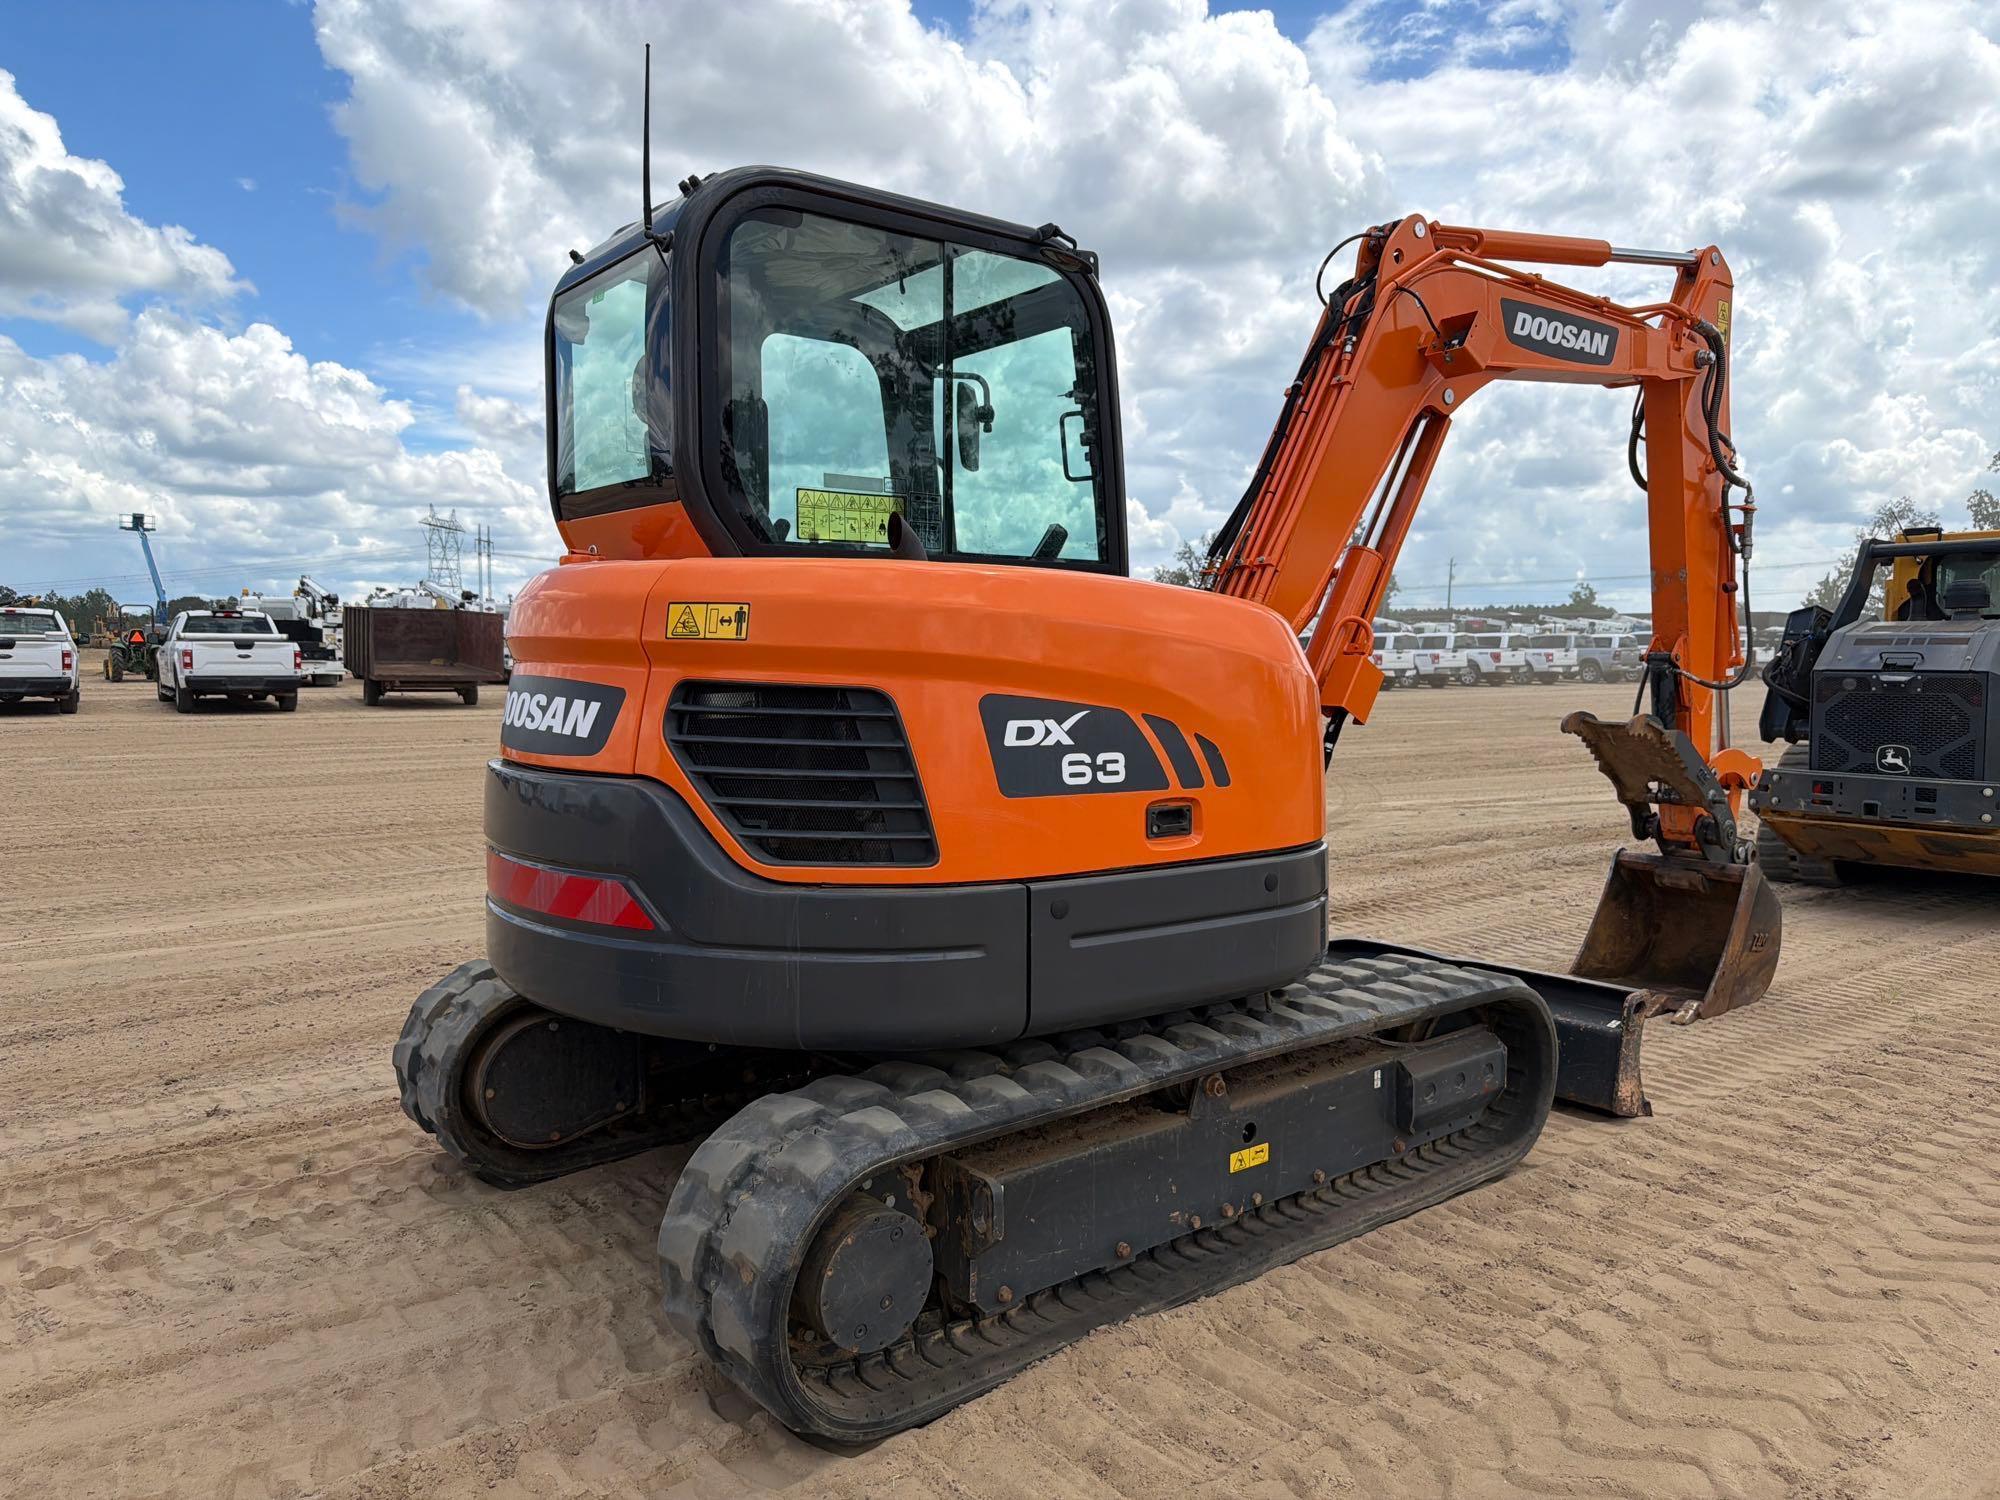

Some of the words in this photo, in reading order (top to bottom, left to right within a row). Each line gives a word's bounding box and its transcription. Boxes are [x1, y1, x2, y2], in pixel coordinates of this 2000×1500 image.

[1513, 311, 1609, 356] DOOSAN
[504, 691, 601, 738] OOSAN
[1003, 710, 1091, 746] DX
[1061, 752, 1126, 785] 63
